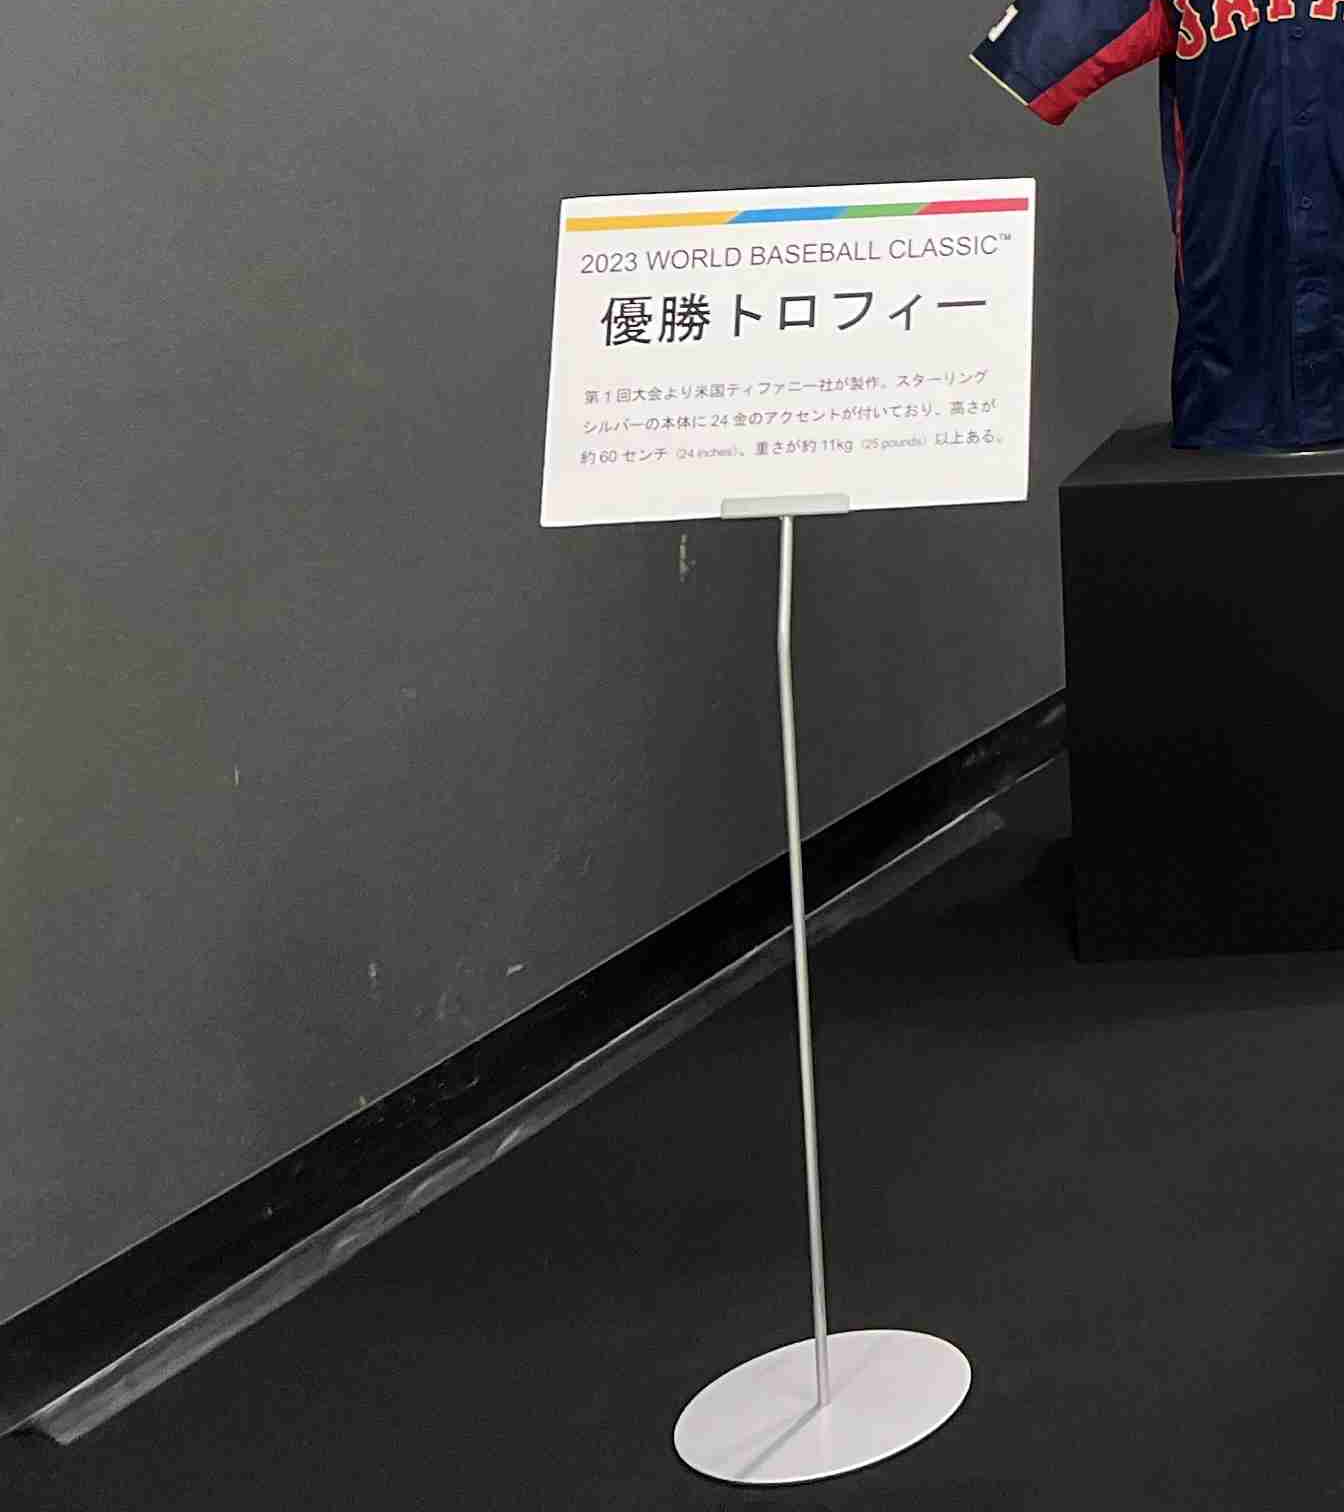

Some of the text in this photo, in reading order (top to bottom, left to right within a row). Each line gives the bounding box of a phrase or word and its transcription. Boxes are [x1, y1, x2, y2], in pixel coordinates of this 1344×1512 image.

[580, 251, 638, 274] 2023
[646, 246, 742, 271] WORLD
[750, 241, 881, 266] BASEBALL
[600, 292, 987, 346] 優勝トロフィー
